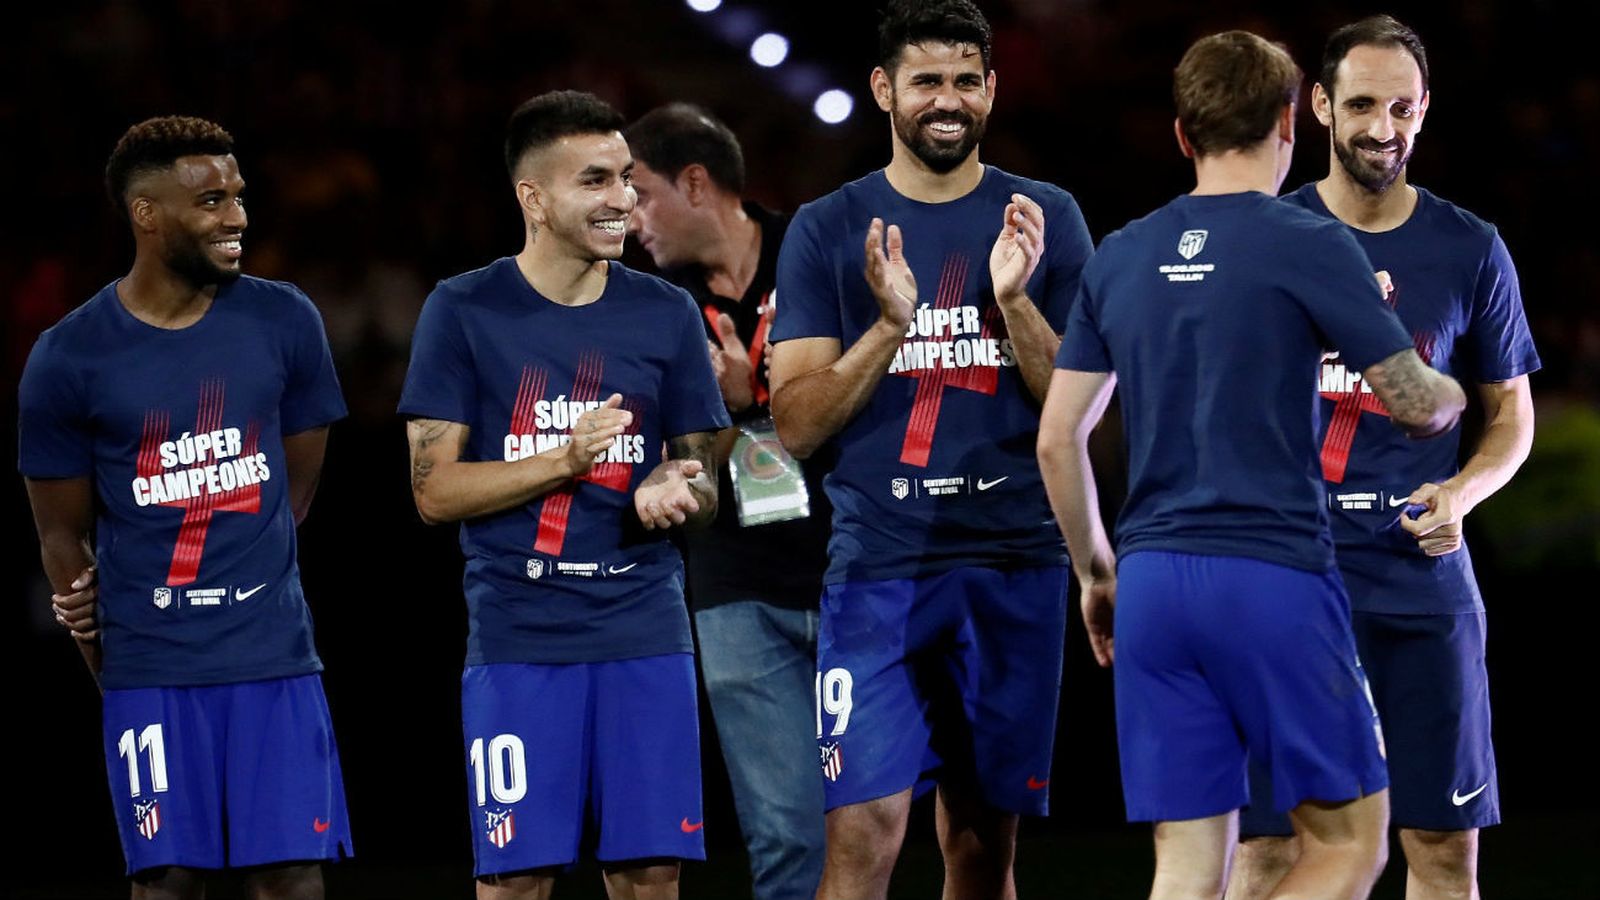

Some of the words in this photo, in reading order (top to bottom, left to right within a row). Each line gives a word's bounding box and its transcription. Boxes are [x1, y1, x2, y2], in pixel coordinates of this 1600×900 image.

[888, 338, 1016, 374] AMPEONES
[534, 395, 606, 430] SÚP
[159, 427, 241, 468] SÚPER
[132, 452, 271, 507] CAMPEONES
[815, 667, 853, 739] 19
[118, 723, 168, 797] 11
[470, 733, 527, 806] 10
